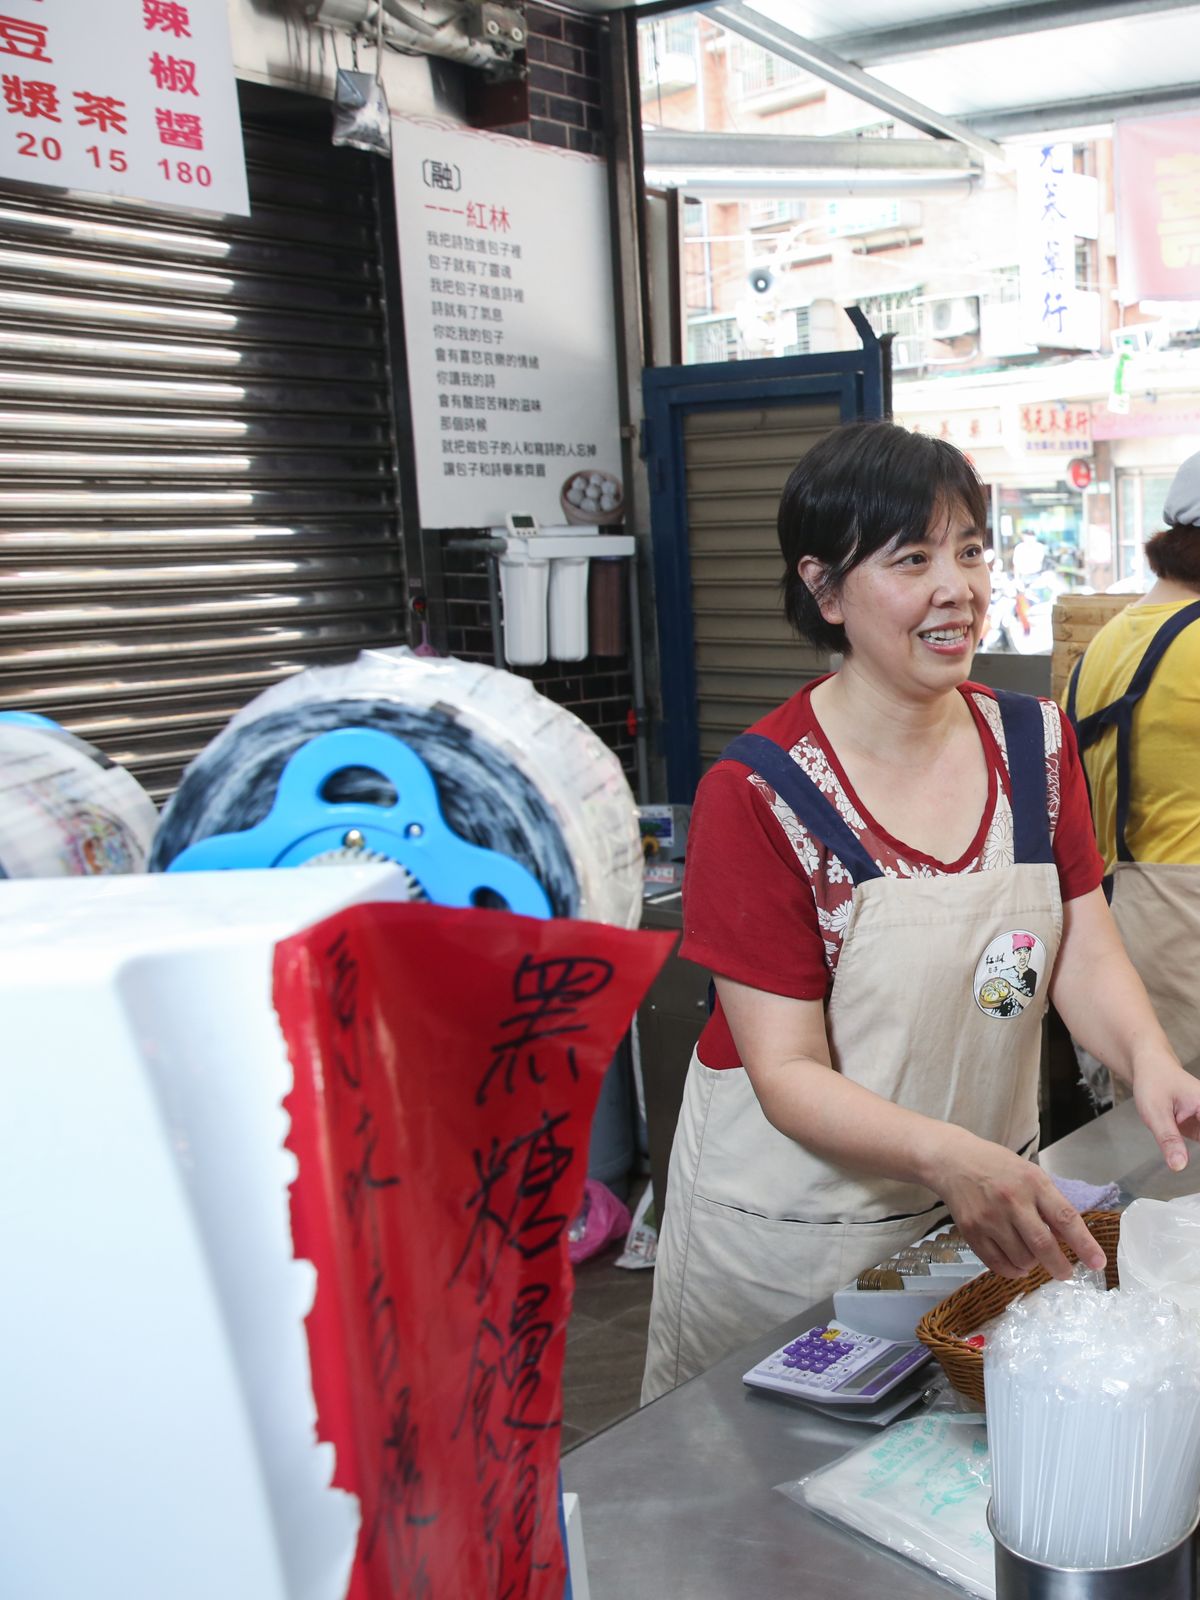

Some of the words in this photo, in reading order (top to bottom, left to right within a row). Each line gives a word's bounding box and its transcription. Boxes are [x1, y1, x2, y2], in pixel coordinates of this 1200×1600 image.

[142, 0, 204, 151] 辣椒醬
[72, 91, 128, 135] 茶
[16, 132, 62, 161] 20
[85, 145, 129, 173] 15
[157, 158, 212, 187] 180
[428, 254, 513, 280] 包子就有了靈魂
[431, 300, 504, 322] 詩就有了氣息
[433, 324, 504, 345] 你吃我的包子
[435, 347, 540, 370] 會有喜怒哀樂的情緒
[436, 370, 496, 388] 你讀我的詩
[438, 393, 542, 412] 會有酸甜苦辣的滋味
[440, 415, 488, 432] 那個時候
